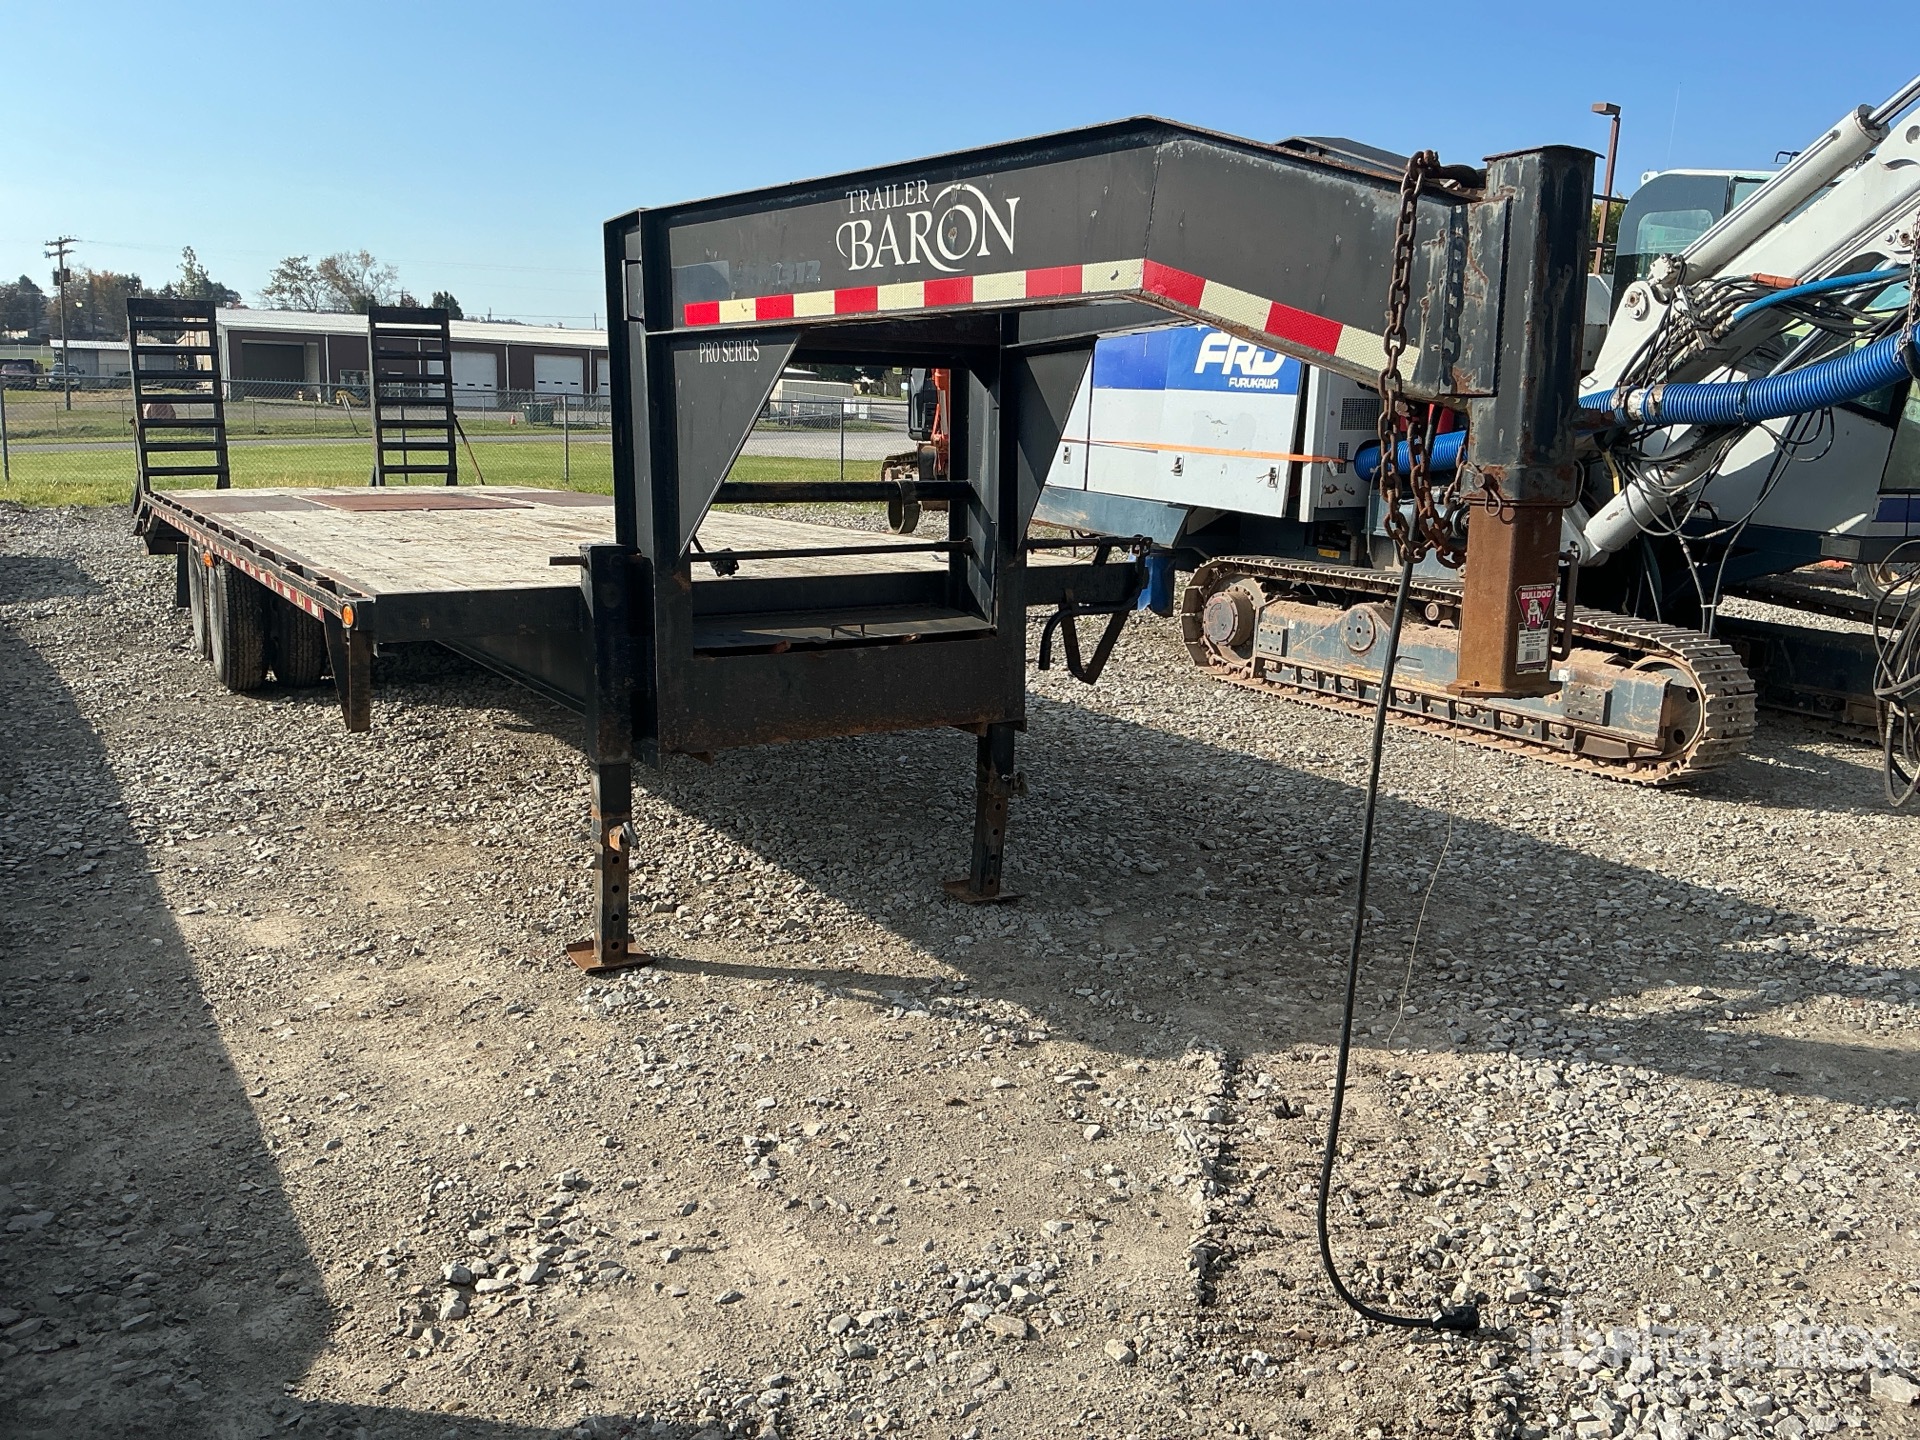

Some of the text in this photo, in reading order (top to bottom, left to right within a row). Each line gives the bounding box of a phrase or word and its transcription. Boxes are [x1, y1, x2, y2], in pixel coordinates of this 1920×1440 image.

[846, 179, 930, 214] TRAILER
[835, 183, 1020, 273] BARON
[699, 339, 760, 363] PRO SERIES
[1194, 331, 1286, 376] FRD
[1228, 377, 1279, 389] FURUKAWA
[1521, 590, 1552, 600] BULLDOG
